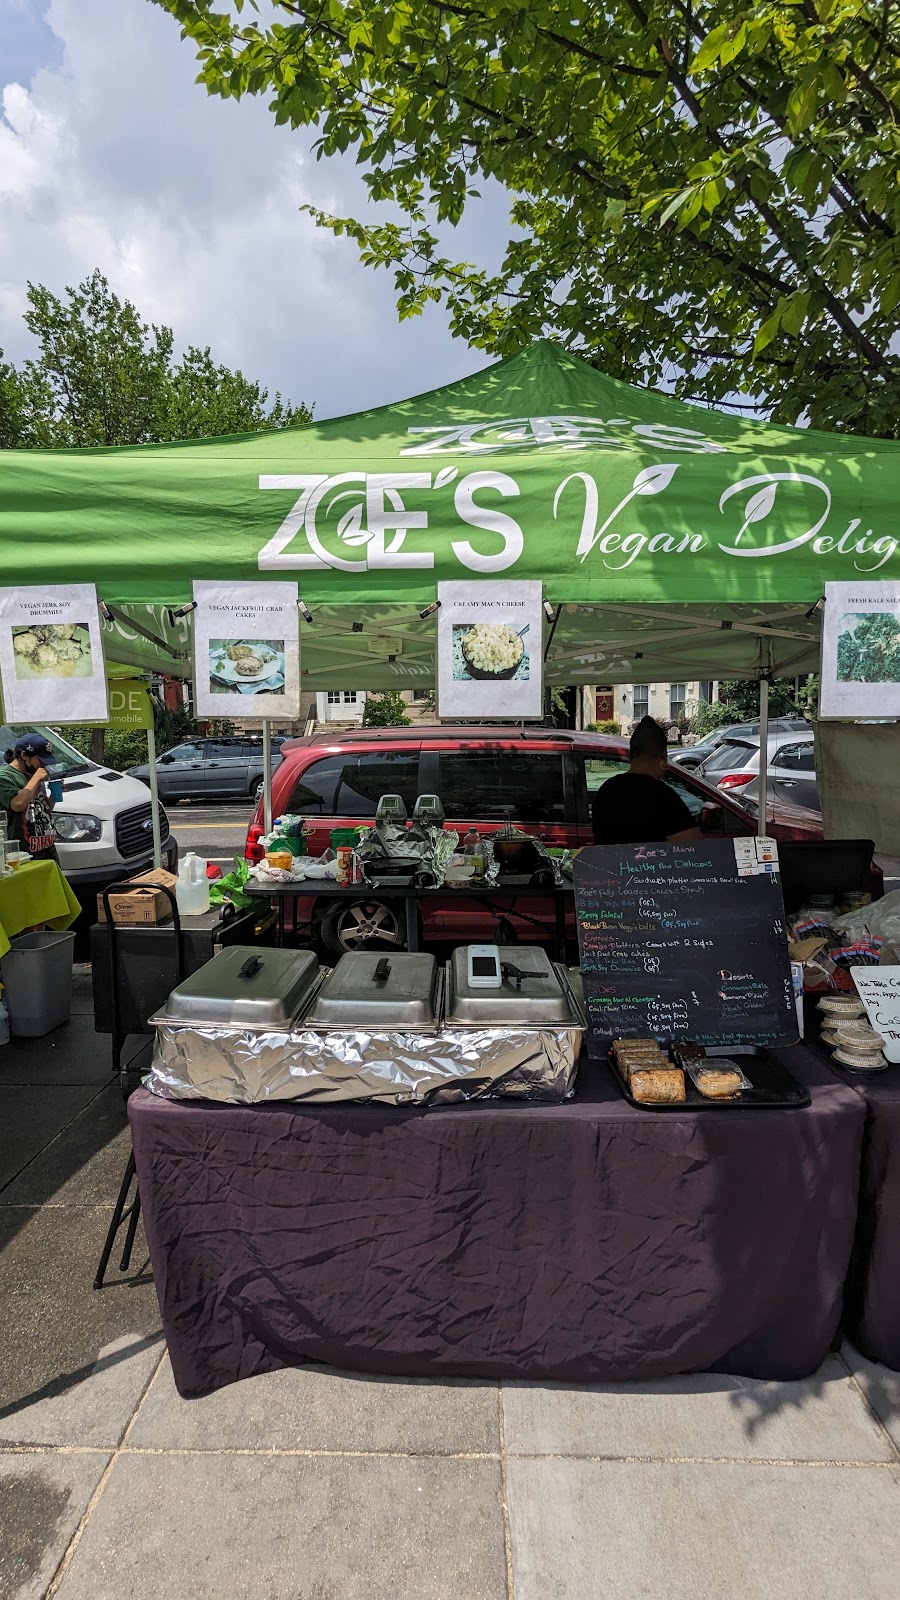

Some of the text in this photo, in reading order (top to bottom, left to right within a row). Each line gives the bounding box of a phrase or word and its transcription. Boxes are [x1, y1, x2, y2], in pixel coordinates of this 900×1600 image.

[258, 466, 524, 573] ZOE'S
[553, 464, 708, 570] Vegan
[634, 845, 695, 860] Zoe's Menu
[620, 861, 656, 876] Healthy
